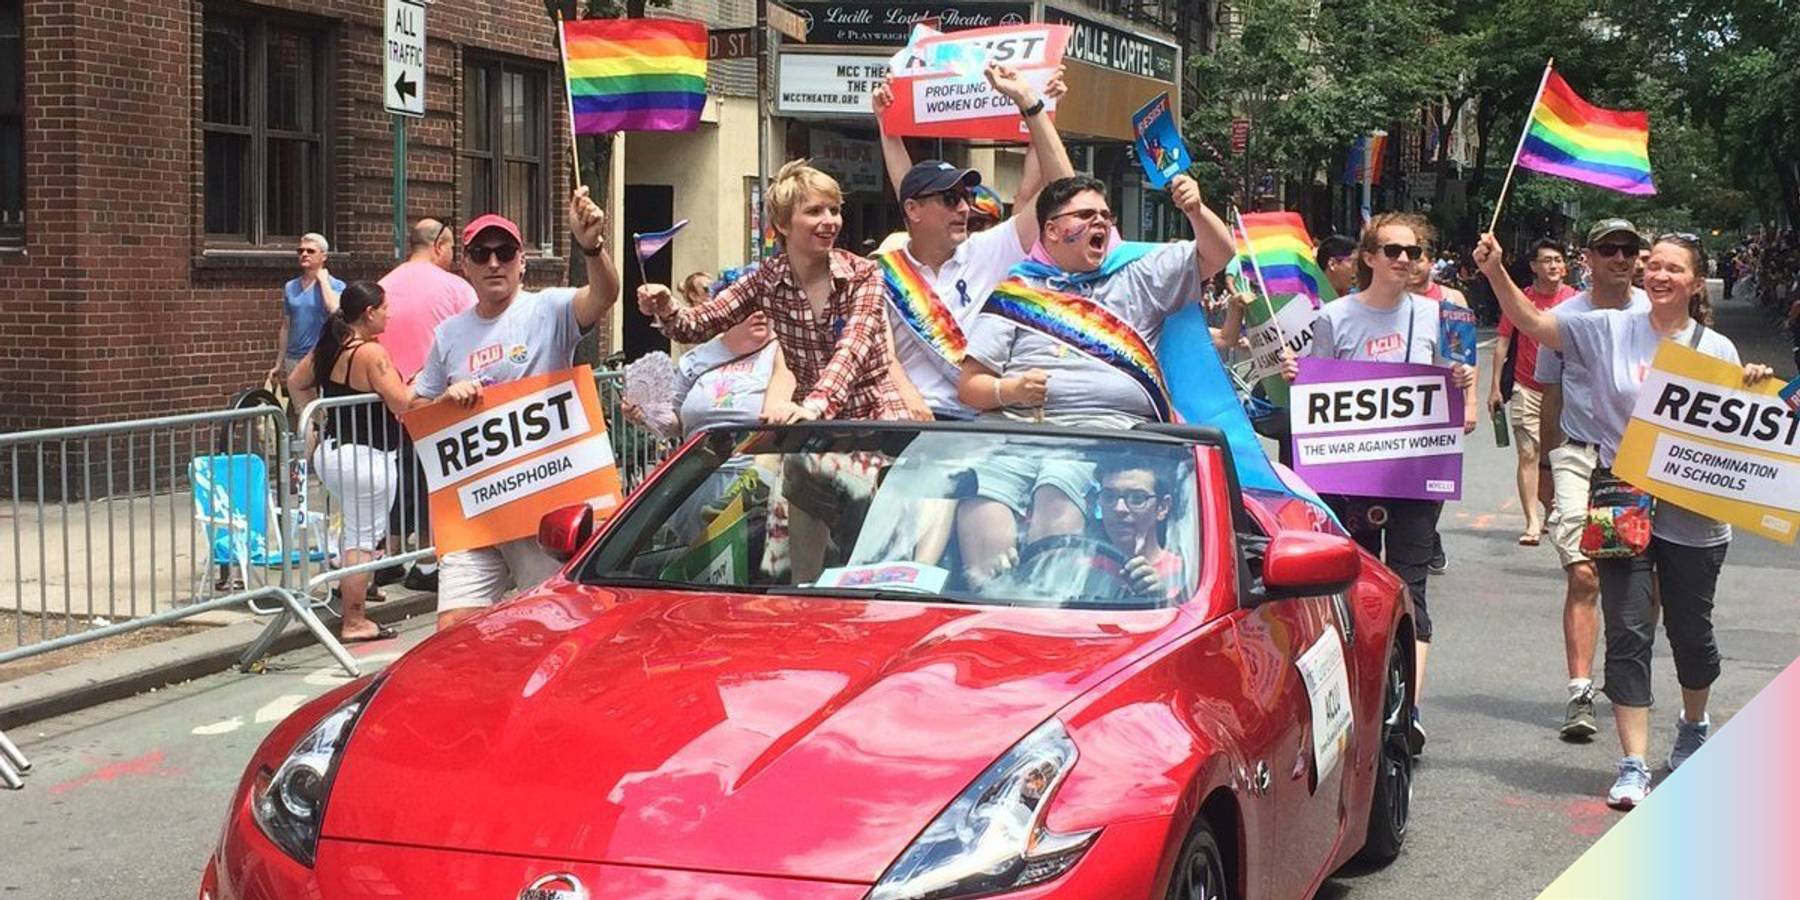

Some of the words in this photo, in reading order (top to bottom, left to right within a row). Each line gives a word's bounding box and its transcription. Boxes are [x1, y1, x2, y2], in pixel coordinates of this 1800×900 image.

[395, 7, 416, 37] ALL
[824, 7, 873, 24] Lucille
[940, 8, 993, 25] Theatre
[728, 33, 748, 56] ST
[837, 30, 845, 39] &
[848, 30, 909, 42] PLAYWRIGH
[1060, 18, 1109, 64] UCILLE
[1113, 35, 1155, 77] LORTEL
[388, 40, 422, 67] TRAFFIC
[837, 66, 860, 77] MCC
[864, 66, 891, 78] THEA
[847, 80, 866, 92] THE
[925, 81, 986, 97] PROFILING
[783, 93, 859, 104] MCCTHEATER.ORG
[926, 99, 971, 113] WOMEN
[974, 98, 988, 110] OF
[991, 95, 1015, 107] COL
[1370, 335, 1400, 355] ACLU
[472, 346, 501, 369] ACLU
[1308, 384, 1441, 425] RESIST
[1653, 382, 1800, 445] RESIST
[436, 391, 573, 477] RESIST
[1303, 445, 1326, 456] THE
[1327, 443, 1355, 454] WAR
[1357, 438, 1406, 452] AGAINST
[1408, 434, 1457, 449] WOMEN
[1668, 445, 1778, 479] DISCRIMINATION
[471, 456, 573, 505] TRANSPHOBIA
[1664, 461, 1680, 476] IN
[1681, 466, 1747, 491] SCHOOLS
